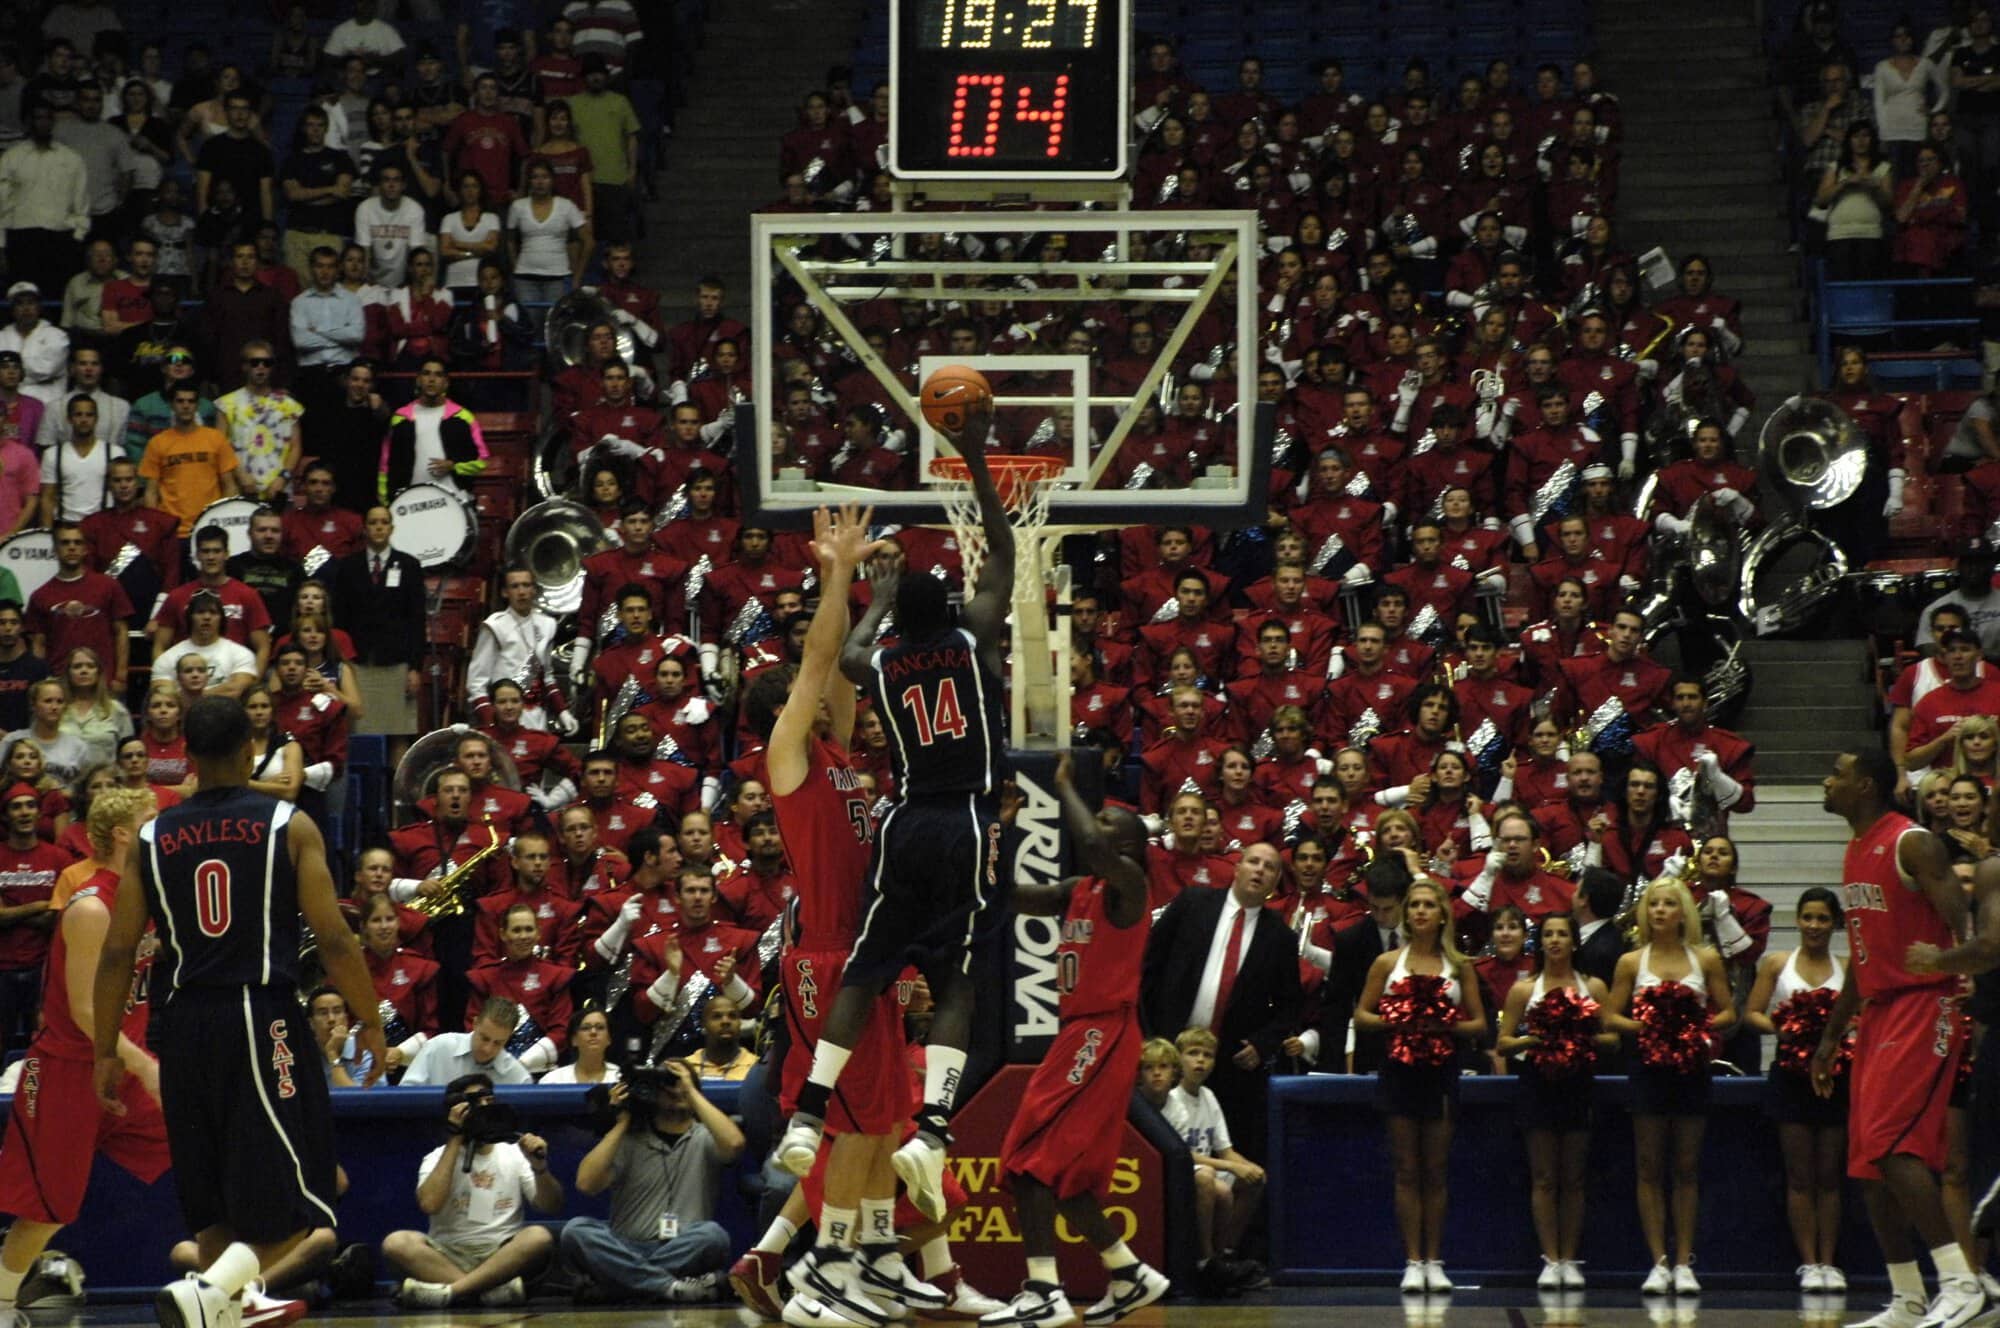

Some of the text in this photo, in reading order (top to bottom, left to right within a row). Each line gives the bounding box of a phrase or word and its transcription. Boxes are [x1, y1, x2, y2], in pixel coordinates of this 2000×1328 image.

[940, 0, 1097, 48] 19:27
[947, 74, 1069, 157] 04
[409, 498, 447, 513] YAMAHA
[884, 648, 971, 684] TANGARA
[902, 676, 968, 746] 14
[159, 817, 266, 856] BAYLESS
[194, 858, 232, 938] 0
[796, 959, 818, 1019] CATS
[269, 1019, 296, 1099] CATS
[1066, 1028, 1104, 1085] CATS
[947, 1205, 1138, 1244] FAO
